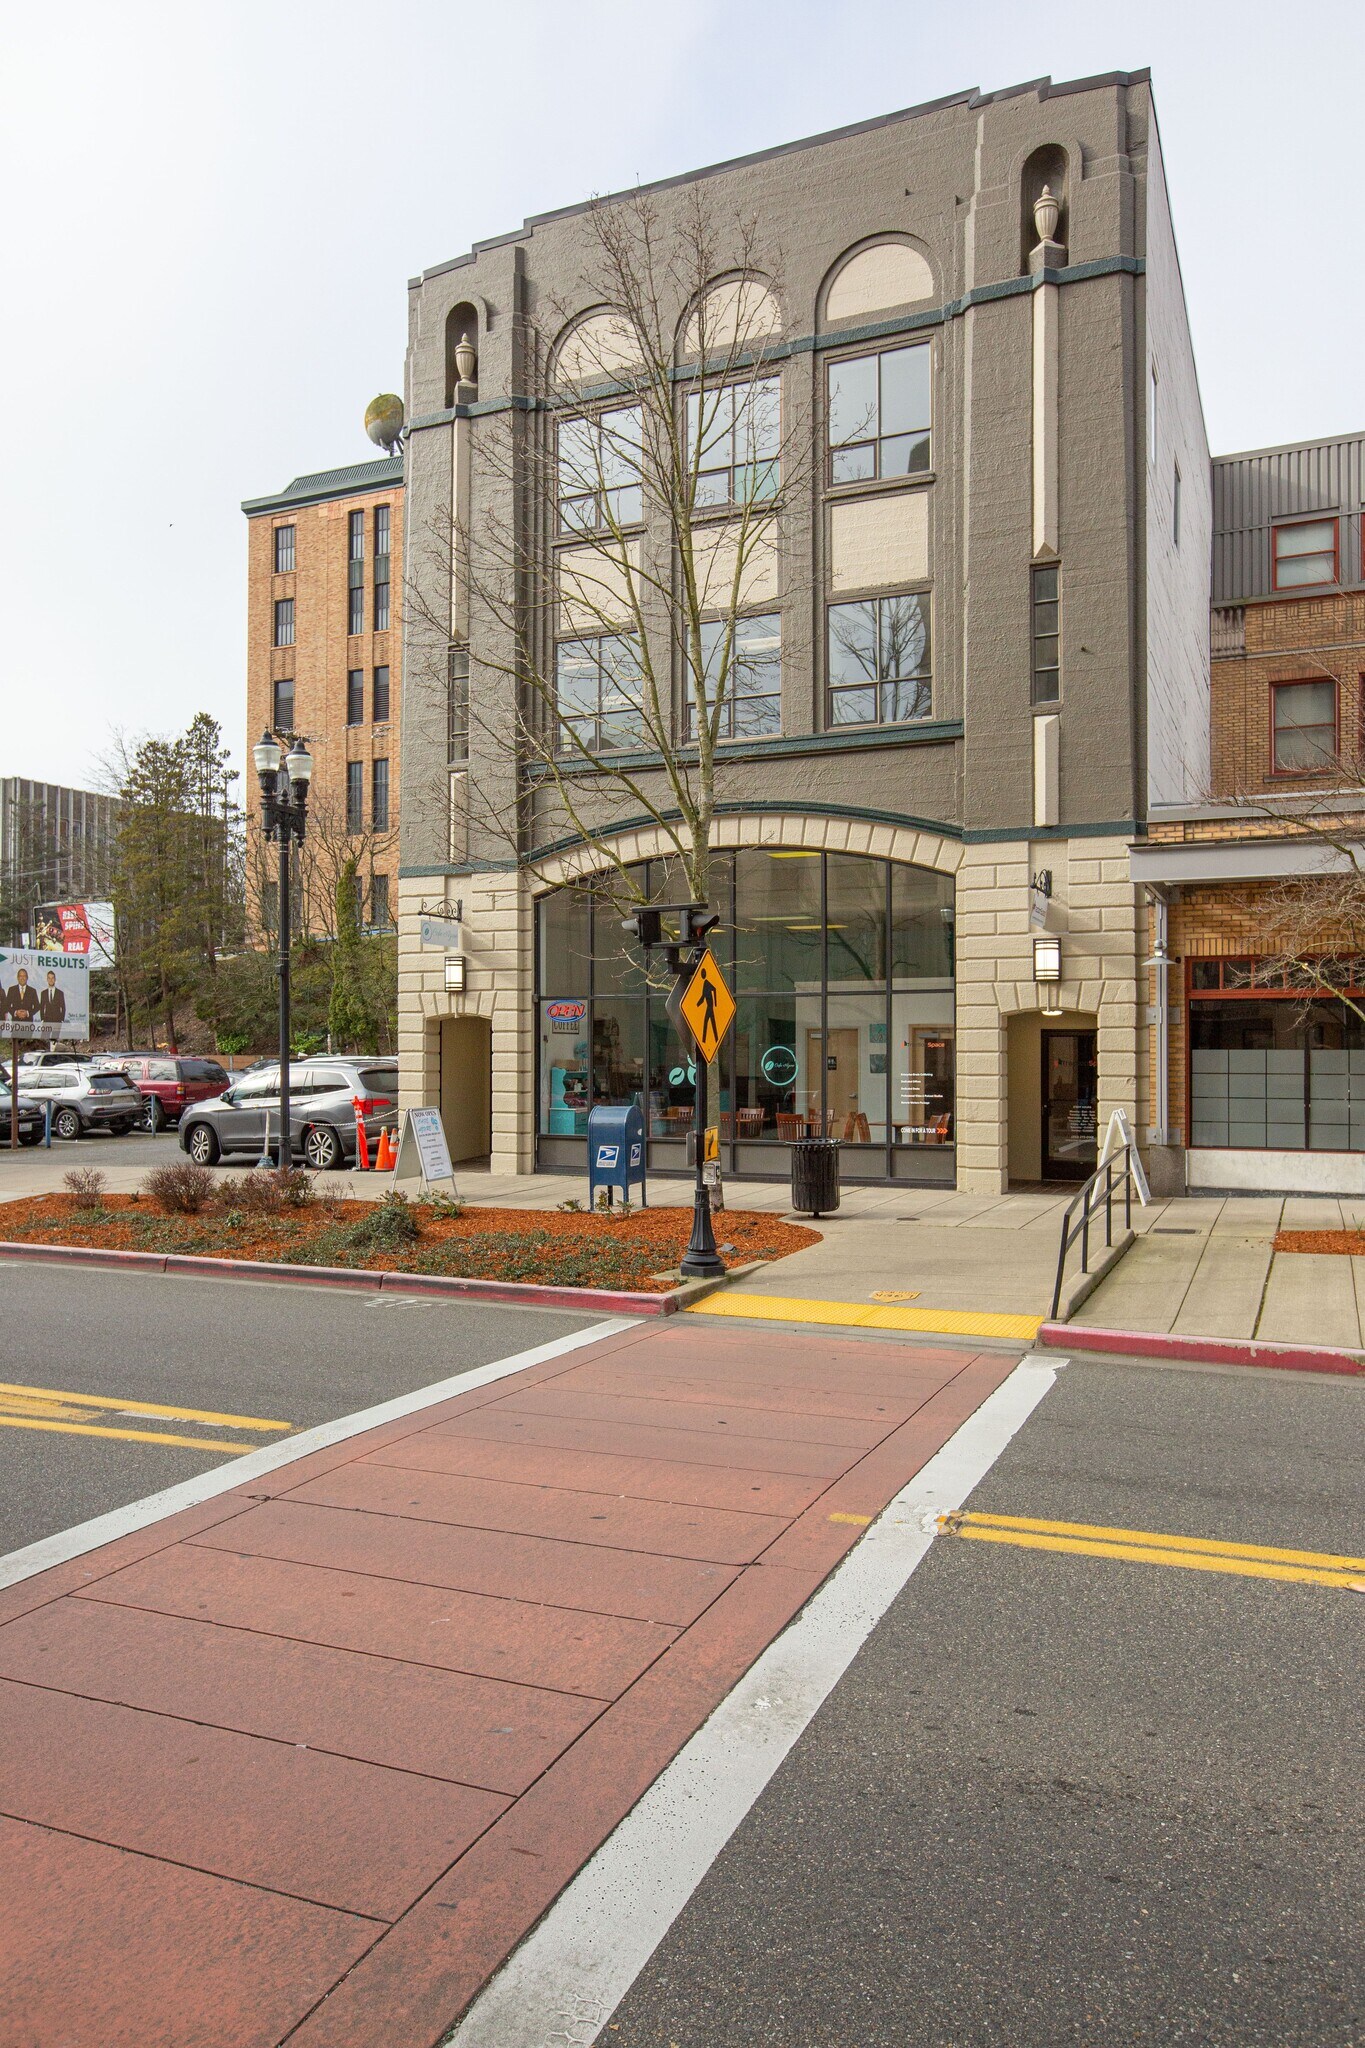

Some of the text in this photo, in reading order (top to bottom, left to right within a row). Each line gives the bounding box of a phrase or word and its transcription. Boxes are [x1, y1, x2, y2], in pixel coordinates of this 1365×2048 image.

[67, 941, 84, 951] REAL
[10, 953, 88, 969] JUST RESULTS.
[547, 1003, 585, 1017] OPEN
[554, 1021, 578, 1030] COFFEE
